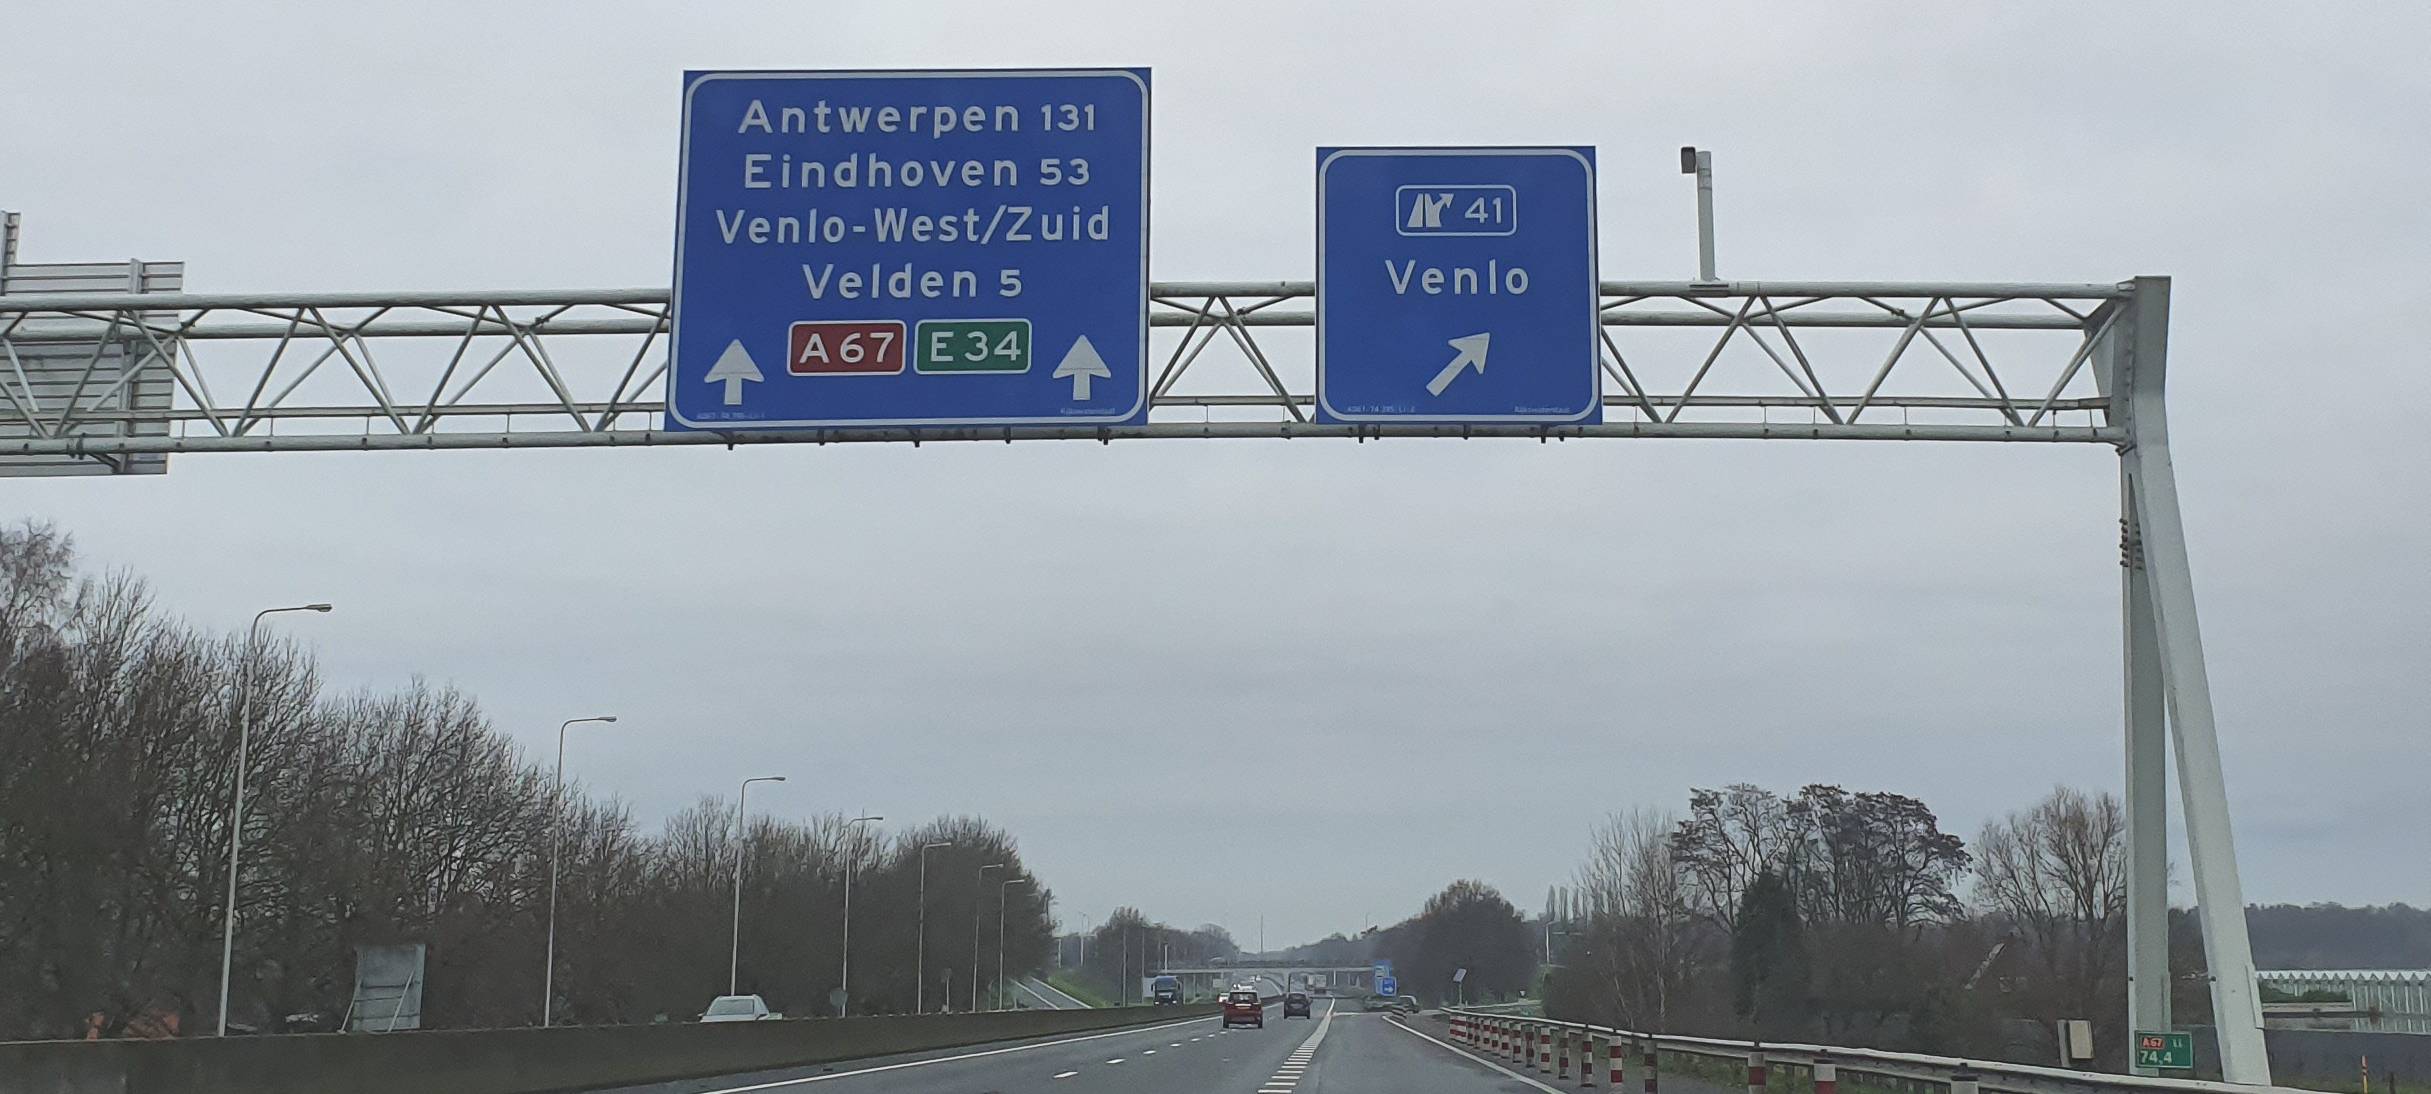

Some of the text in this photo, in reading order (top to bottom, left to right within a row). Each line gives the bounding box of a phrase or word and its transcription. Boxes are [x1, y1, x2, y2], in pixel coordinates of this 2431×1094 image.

[738, 99, 1095, 139] Antwerpen 131
[745, 153, 1090, 189] Eindhoven 53
[717, 205, 1109, 244] Venlo-West/Zuid
[1465, 197, 1502, 223] 41
[803, 263, 1022, 299] Velden 5
[1385, 259, 1528, 295] Venlo
[2141, 1051, 2172, 1064] 74,4
